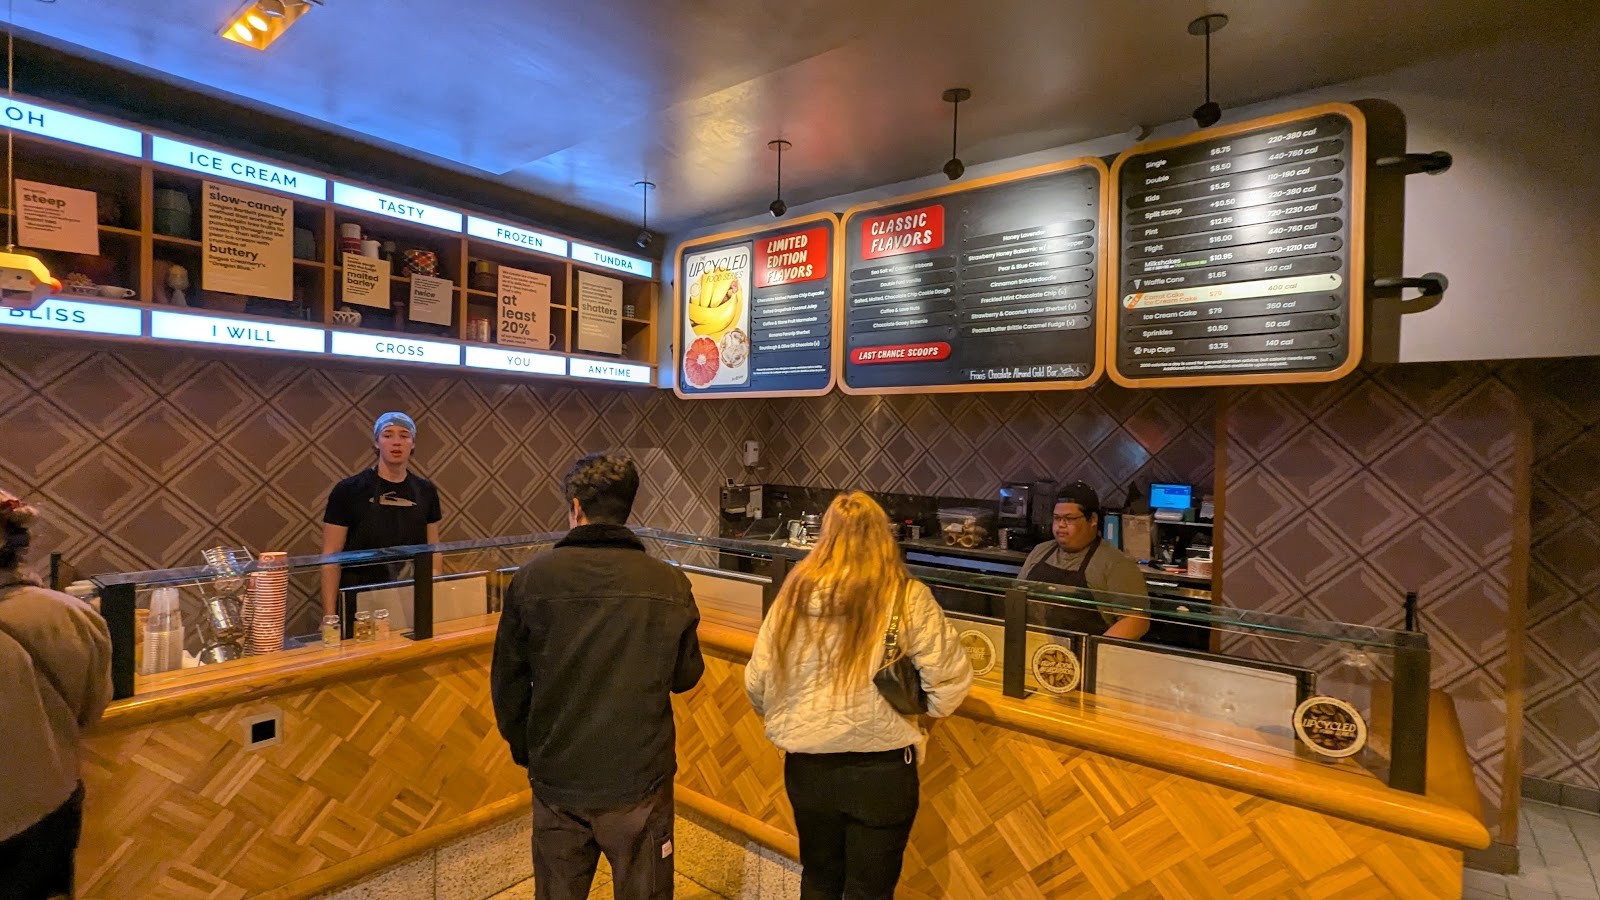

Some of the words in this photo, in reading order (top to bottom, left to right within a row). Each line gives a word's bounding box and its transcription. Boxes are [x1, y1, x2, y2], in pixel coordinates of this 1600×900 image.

[5, 106, 44, 128] OH
[1145, 159, 1167, 169] Single
[1210, 145, 1231, 156] $6.75
[1267, 130, 1302, 144] 220-380
[1302, 127, 1318, 137] cal
[189, 151, 223, 171] ICE
[230, 162, 298, 188] CREAM
[1145, 175, 1170, 185] Double
[1209, 162, 1232, 172] $8.50
[1268, 148, 1303, 161] 440-760
[1303, 145, 1319, 155] cal
[1144, 194, 1160, 203] Kids
[1209, 181, 1231, 191] $5.25
[1267, 169, 1296, 181] 110-190
[1296, 166, 1311, 176] cal
[23, 193, 67, 209] steep
[209, 192, 288, 217] slow-candy
[379, 198, 425, 219] TASTY
[1144, 210, 1161, 220] Split
[1160, 207, 1183, 217] Scoop
[1209, 198, 1236, 208] +$0.50
[1267, 187, 1302, 199] 220-380
[1302, 184, 1318, 194] cal
[871, 212, 928, 236] CLASSIC
[1144, 228, 1159, 236] Pint
[1209, 216, 1233, 226] $12.95
[1267, 205, 1303, 217] 720-1230
[1303, 203, 1319, 212] cal
[497, 228, 544, 248] FROZEN
[766, 234, 808, 254] LIMITED
[870, 229, 933, 253] FLAVORS
[1002, 234, 1020, 242] Honey
[1020, 230, 1046, 239] Lavender
[1144, 244, 1164, 253] Flight
[1209, 234, 1233, 243] $16.00
[1267, 224, 1303, 235] 440-760
[1303, 221, 1318, 231] cal
[209, 243, 259, 261] buttery
[766, 249, 808, 269] EDITION
[968, 253, 996, 261] Strawberry
[996, 250, 1013, 258] Honey
[1013, 246, 1039, 255] Balsamic
[1144, 257, 1182, 268] Milkshakes
[1209, 252, 1233, 262] $10.95
[1267, 243, 1303, 255] 870-1210
[1303, 241, 1318, 250] cal
[593, 252, 633, 270] TUNDRA
[688, 253, 748, 278] UPCYCLED
[1028, 260, 1050, 268] Cheese
[347, 271, 379, 282] malted
[766, 264, 813, 283] FLAVORS
[990, 279, 1019, 288] Cinnamon
[1018, 274, 1057, 285] Snickerdoodle
[1143, 277, 1166, 286] Waffle
[1166, 276, 1185, 284] Cone
[1207, 270, 1227, 279] $1.65
[1264, 265, 1278, 273] 140
[1278, 263, 1293, 271] cal
[347, 278, 376, 290] barley
[934, 287, 951, 295] Dough
[414, 289, 436, 298] twice
[502, 295, 517, 306] at
[980, 296, 1003, 304] Freckled
[1015, 292, 1044, 300] Chocolate
[1057, 288, 1067, 296] (v)
[1179, 295, 1198, 303] Cake
[502, 306, 537, 323] least
[582, 303, 618, 316] shatters
[971, 311, 999, 319] Strawberry
[1004, 308, 1028, 316] Coconut
[1027, 306, 1045, 314] Water
[1045, 304, 1067, 312] Sherbet
[1067, 302, 1077, 311] (v)
[1154, 311, 1178, 319] Cream
[1178, 309, 1198, 317] Cake
[1208, 307, 1223, 315] $79
[1265, 302, 1282, 310] 360
[1282, 300, 1297, 308] cal
[212, 324, 216, 337] I
[226, 326, 276, 343] WILL
[501, 320, 530, 335] 20%
[990, 325, 1007, 333] Butter
[1022, 322, 1048, 330] Caramel
[1047, 320, 1066, 328] Fudge
[1066, 319, 1075, 327] (v)
[1142, 328, 1174, 338] Sprinkles
[1207, 324, 1229, 333] $0.50
[1264, 320, 1276, 328] 50
[1276, 319, 1291, 328] cal
[375, 342, 425, 357] CROSS
[858, 351, 877, 360] LAST
[877, 349, 905, 359] CHANCE
[907, 346, 939, 357] SCOOPS
[1156, 346, 1176, 355] Cups
[1208, 342, 1229, 350] $3.75
[1265, 339, 1280, 347] 140
[1280, 338, 1294, 346] cal
[506, 355, 531, 367] YOU
[588, 365, 631, 378] ANYTIME
[987, 367, 1012, 380] Chocolate
[1012, 367, 1032, 379] Almond
[1031, 366, 1045, 378] Gold
[1046, 365, 1059, 377] Bar
[1302, 718, 1357, 732] UPCYCLED
